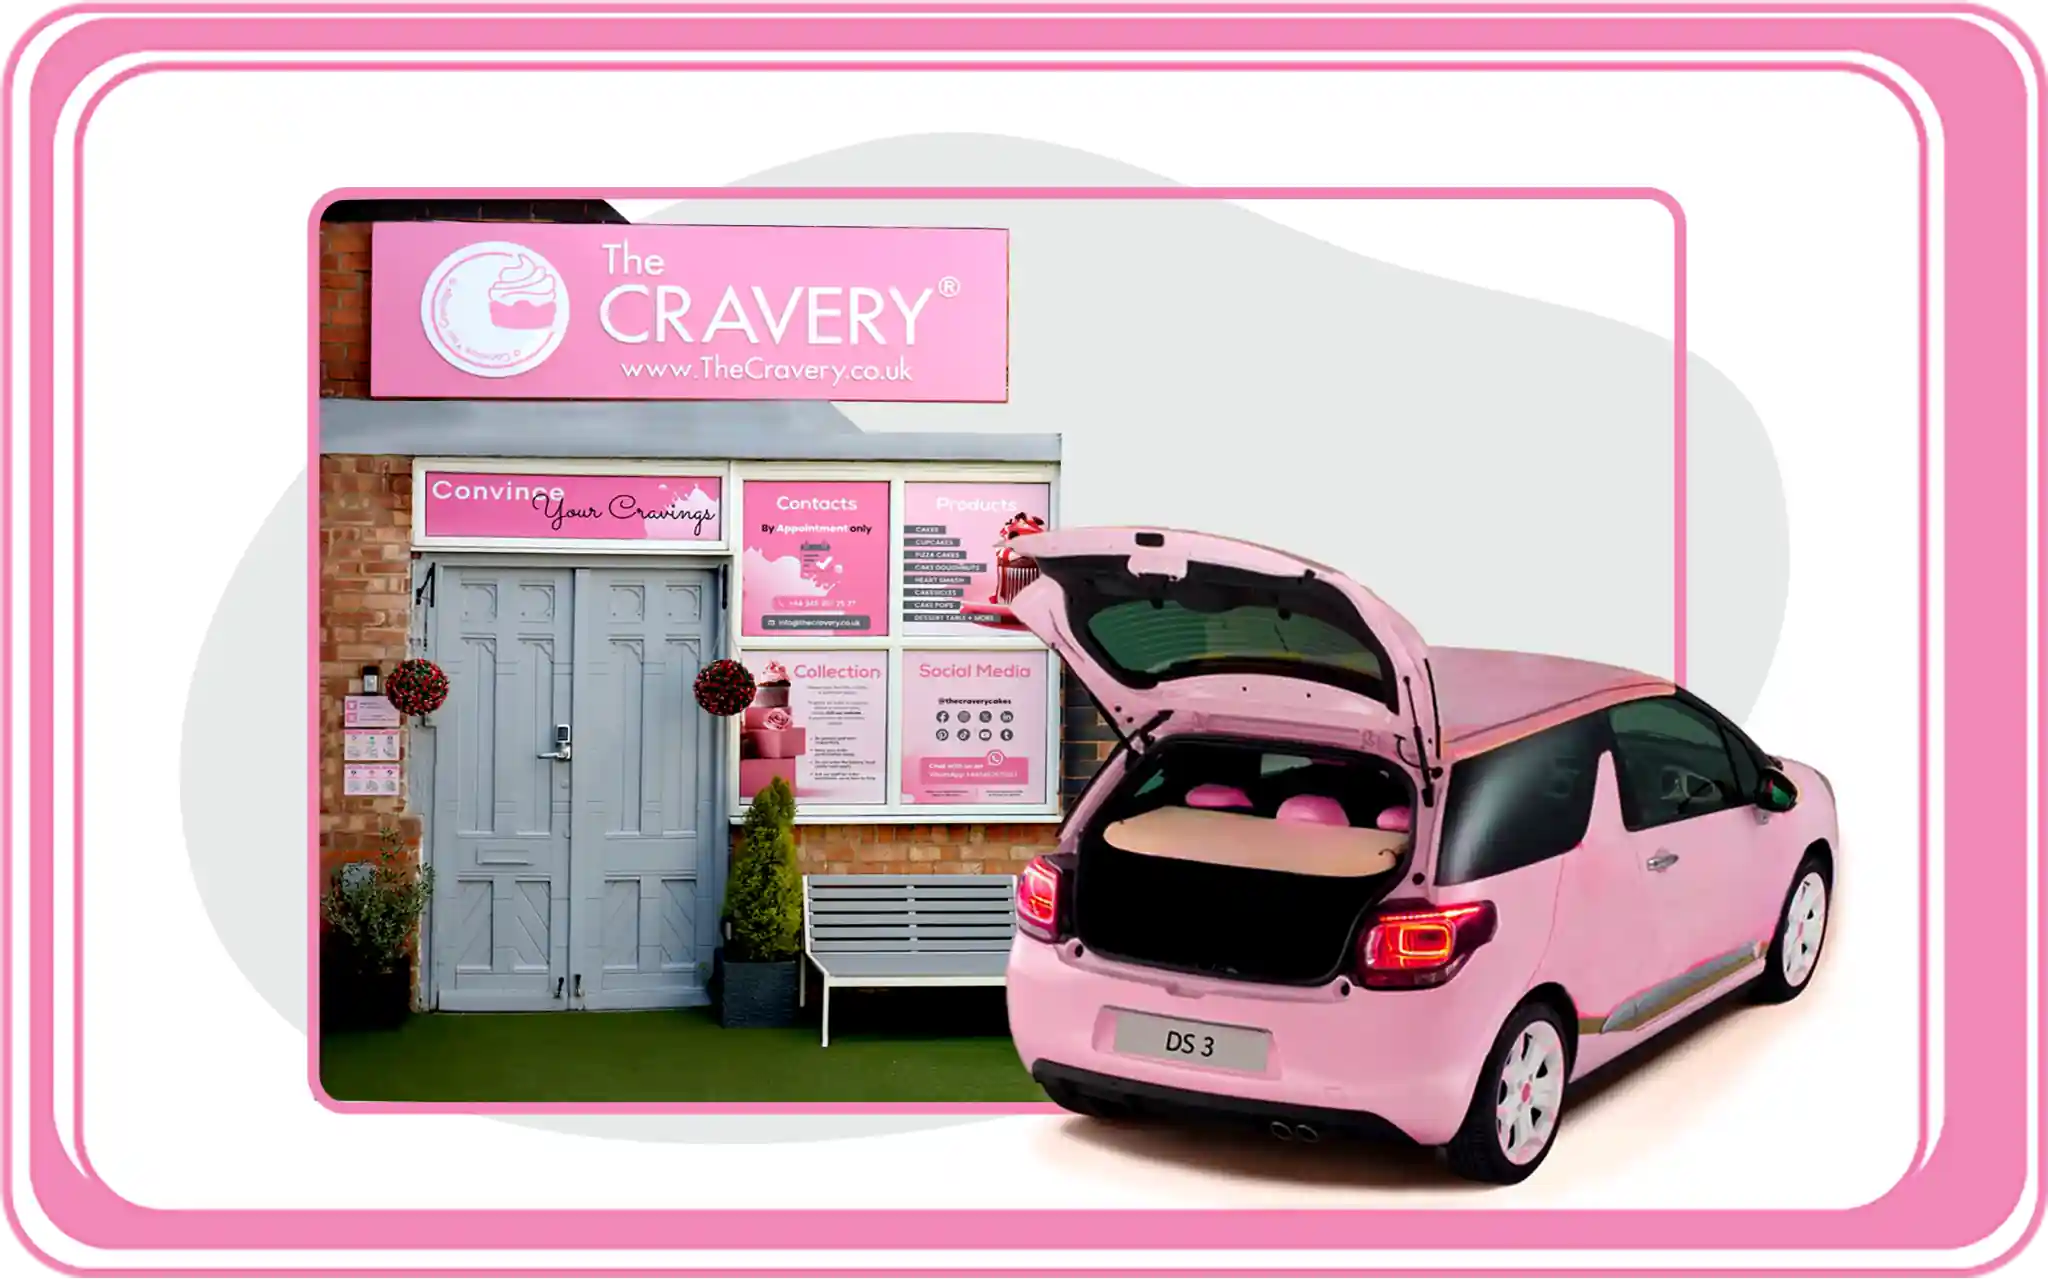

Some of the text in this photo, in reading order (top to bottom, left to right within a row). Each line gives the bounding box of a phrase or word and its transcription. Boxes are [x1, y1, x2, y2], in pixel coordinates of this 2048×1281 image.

[601, 237, 666, 276] The
[599, 283, 935, 346] CRAVERY
[621, 354, 914, 387] www.TheCravery.co.uk
[432, 480, 565, 501] Convince
[776, 496, 858, 511] Contacts
[936, 497, 1018, 512] Products
[532, 493, 716, 536] Your Cravings
[761, 524, 872, 535] By Appointment only
[794, 664, 881, 679] Collection
[919, 664, 1031, 678] Social Media
[938, 697, 1012, 706] @thecraverycakes
[1165, 1030, 1215, 1057] DS 3
